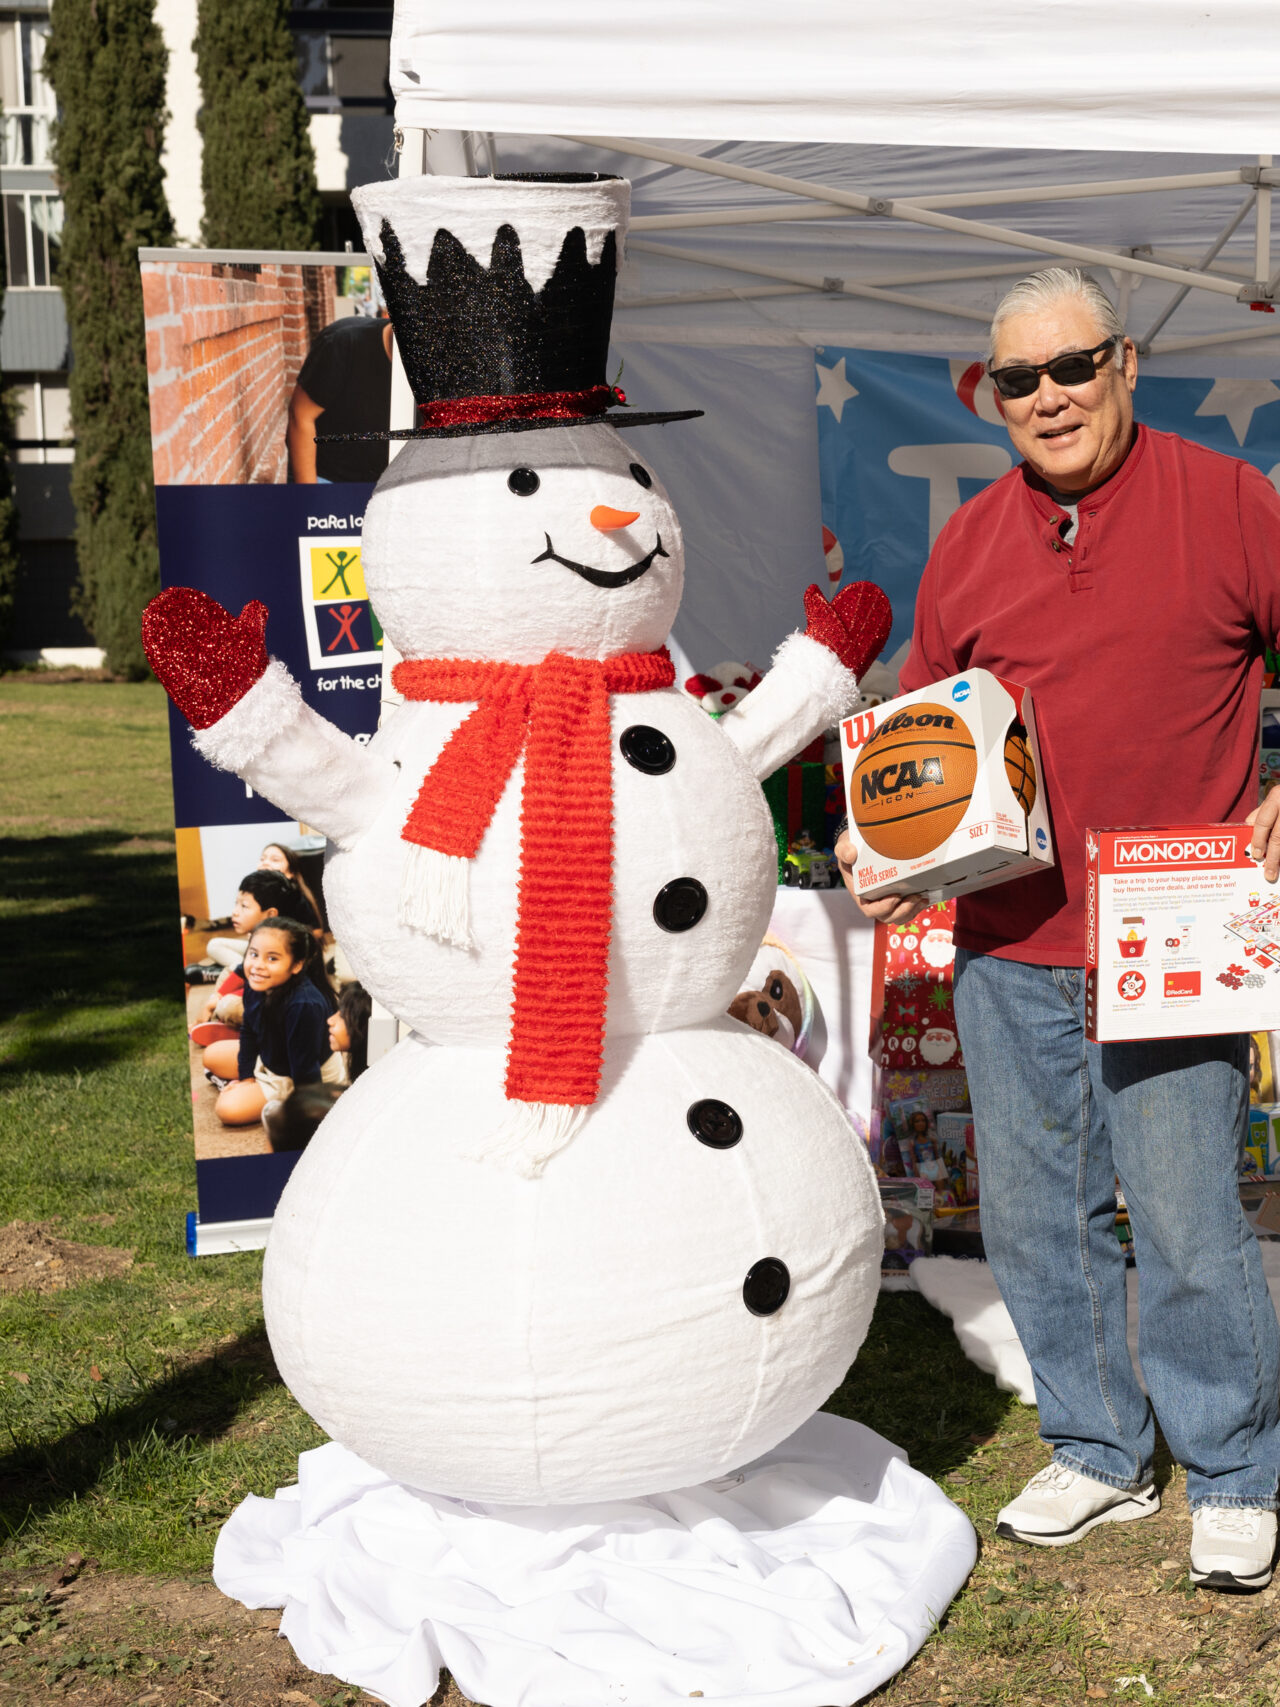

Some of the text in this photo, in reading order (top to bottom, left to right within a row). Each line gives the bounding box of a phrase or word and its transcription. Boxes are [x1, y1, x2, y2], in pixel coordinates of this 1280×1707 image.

[317, 677, 338, 691] for
[340, 675, 365, 690] the
[861, 757, 945, 805] NCAA
[881, 792, 914, 806] ICON
[969, 826, 984, 839] SIZE
[984, 823, 989, 834] 7
[1119, 840, 1232, 863] MONOPOLY
[859, 866, 898, 889] SILVER SERIES
[1135, 877, 1147, 887] trip
[1155, 877, 1170, 885] your
[1171, 875, 1190, 884] happy
[1191, 874, 1208, 883] place
[1219, 874, 1231, 882] you
[1113, 887, 1125, 895] buy
